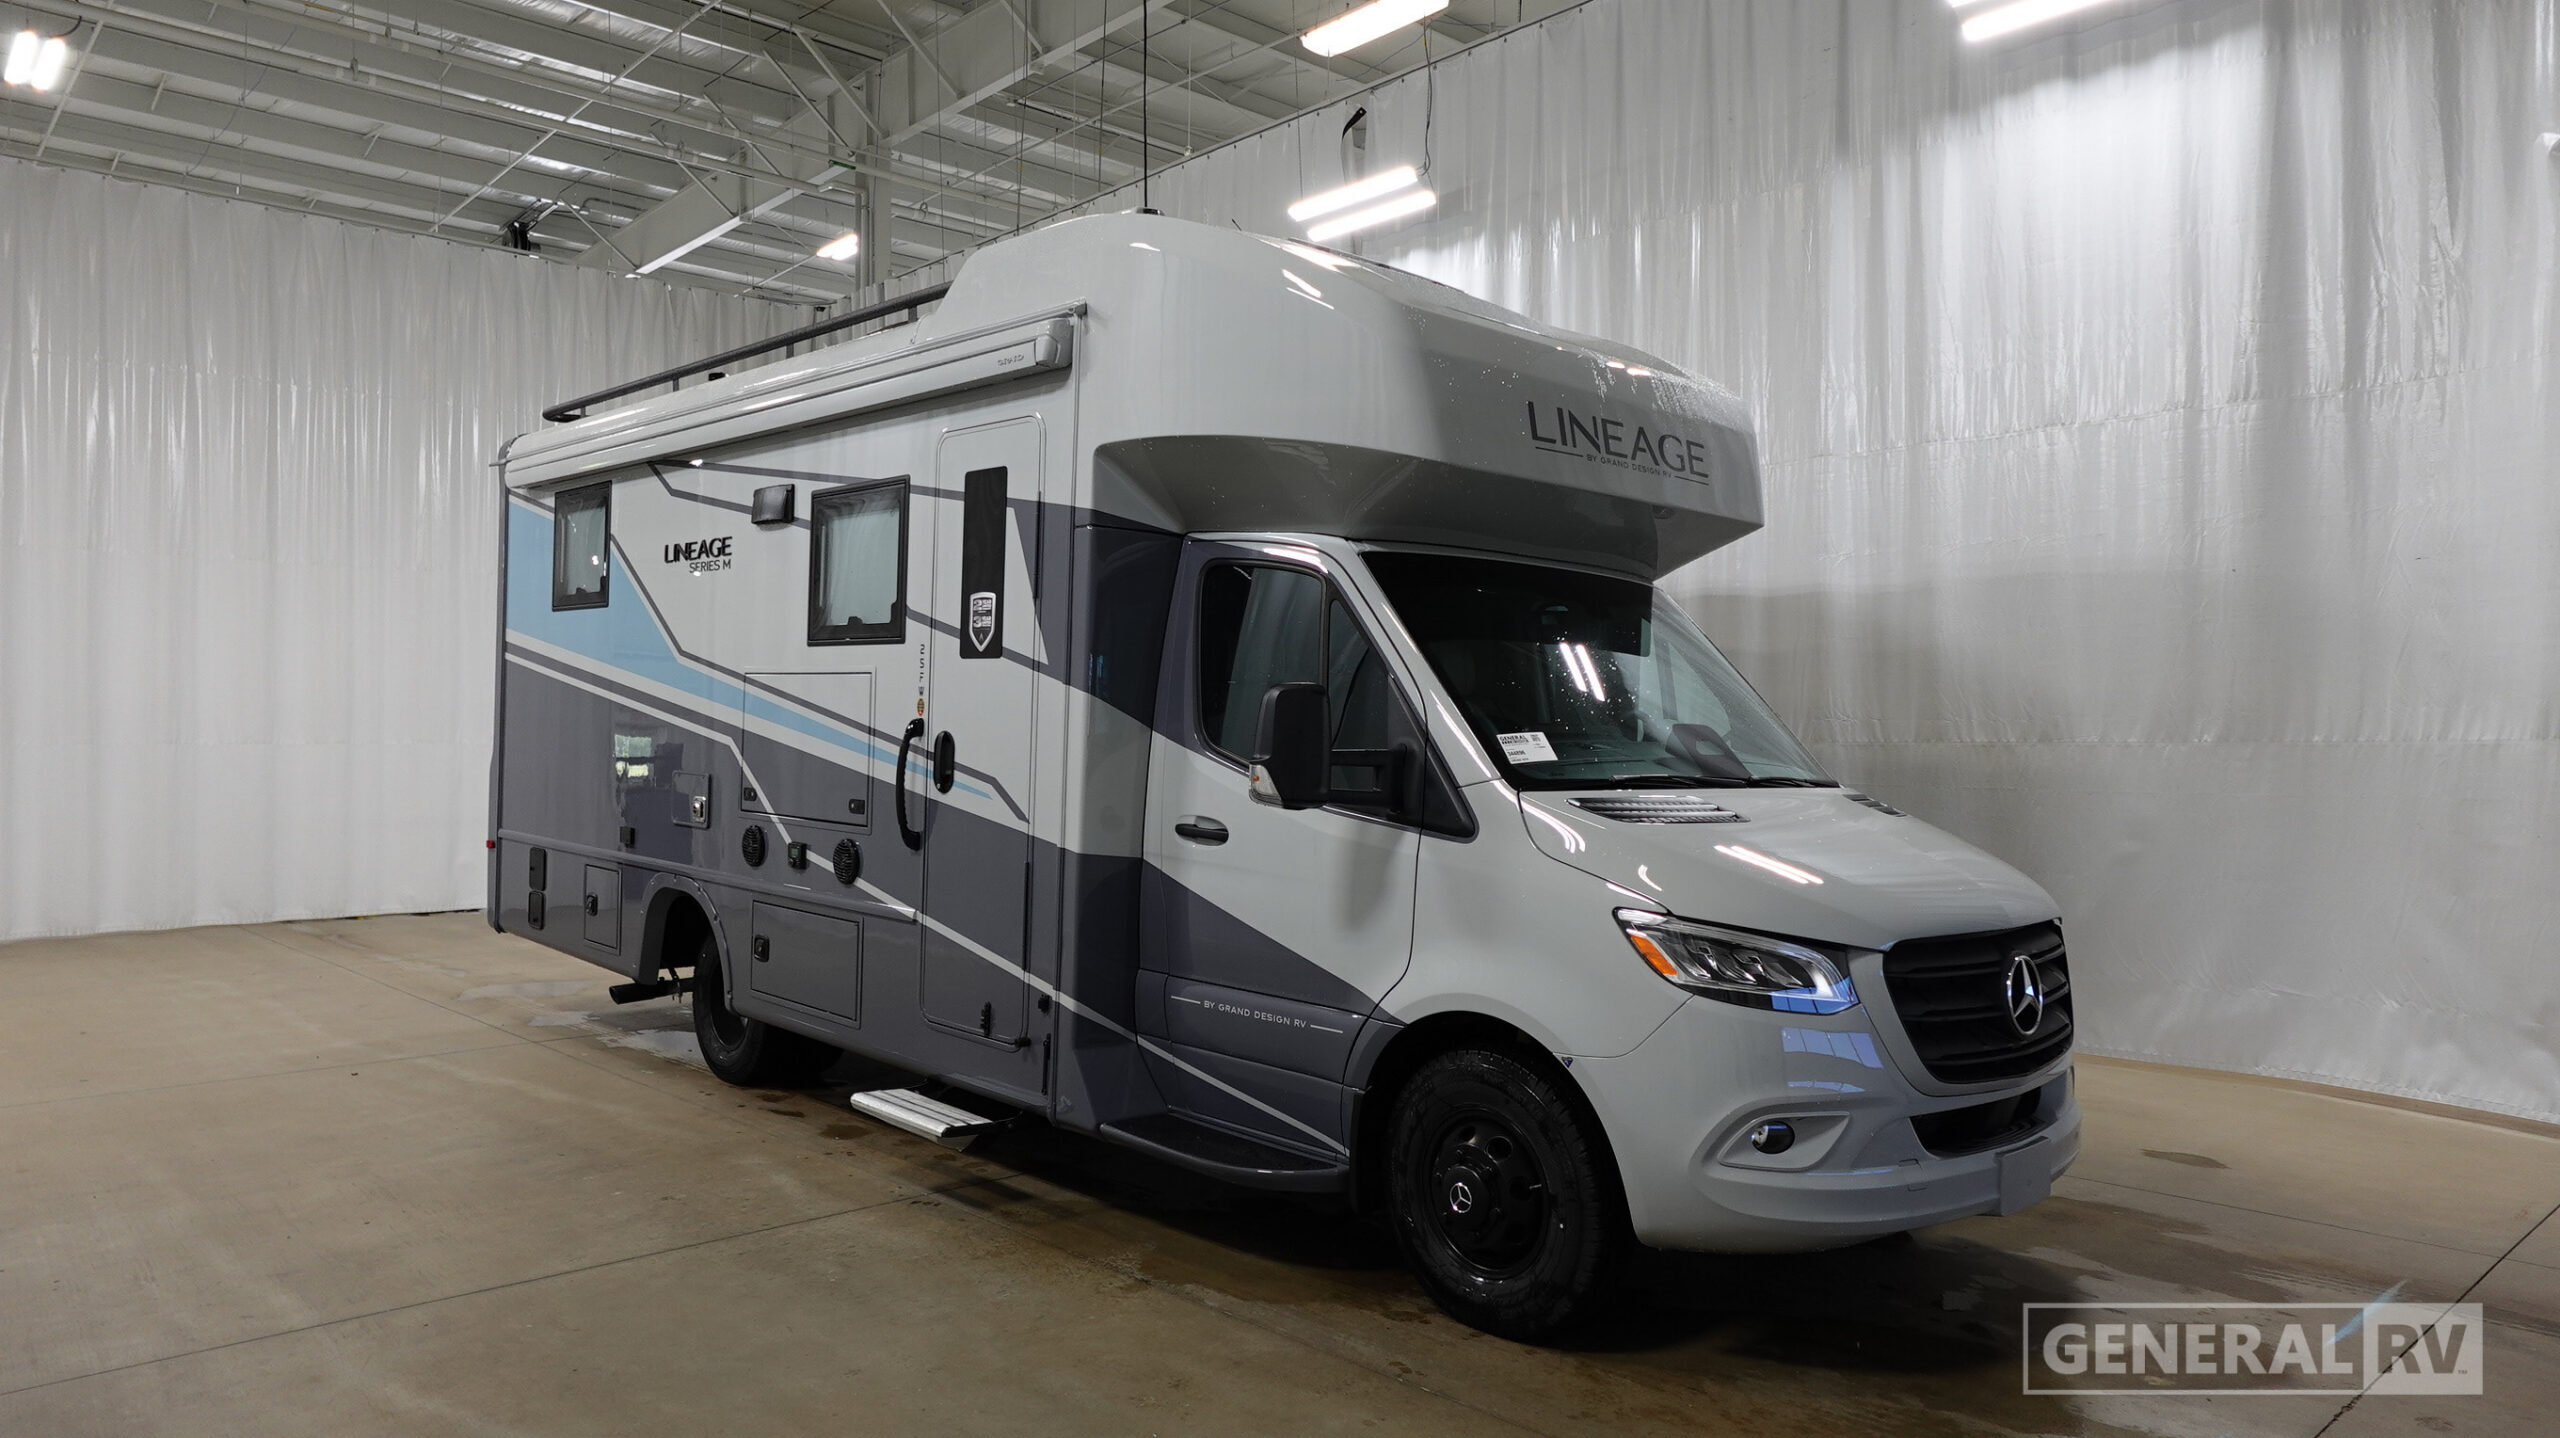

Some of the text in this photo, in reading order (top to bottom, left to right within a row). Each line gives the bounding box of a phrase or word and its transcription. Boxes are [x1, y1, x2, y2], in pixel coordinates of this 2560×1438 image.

[1526, 400, 1710, 479] LINEAGE
[1586, 453, 1598, 462] BY
[1600, 456, 1629, 469] GRAND
[1632, 463, 1661, 476] DESIGN
[664, 536, 733, 563] LINEAGE
[689, 558, 732, 573] SERIES M
[1203, 1000, 1307, 1028] BY GRAND DESIGN RV
